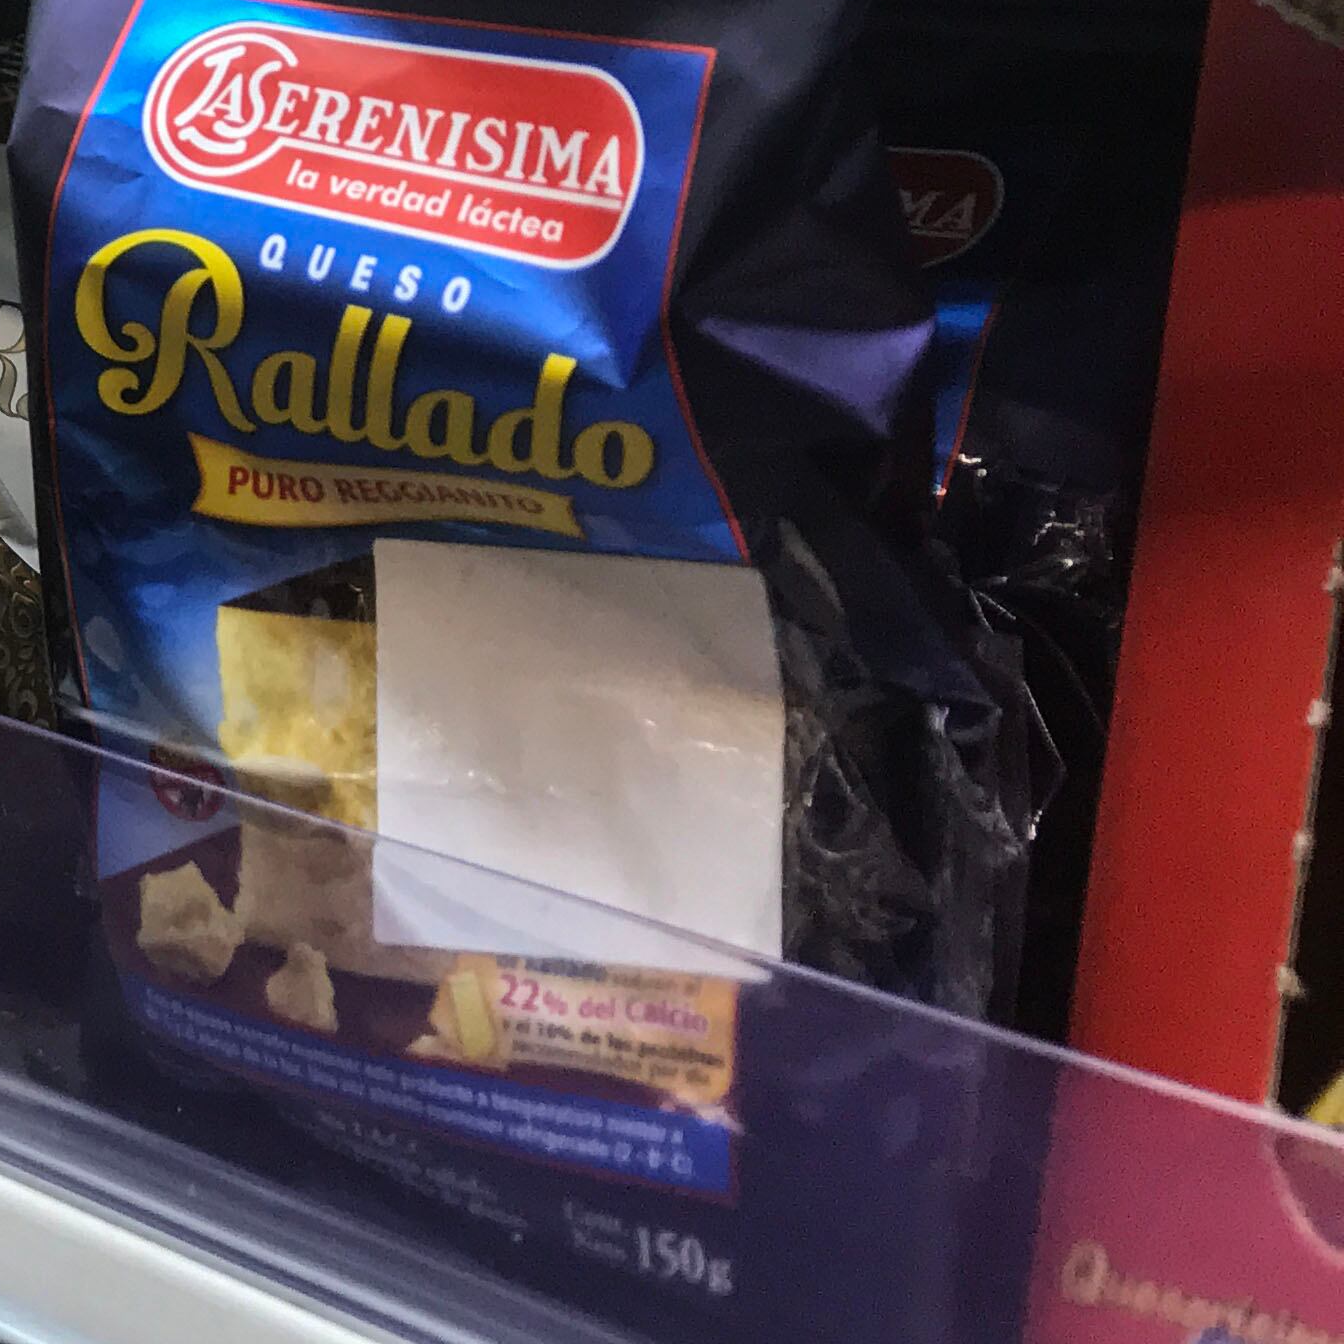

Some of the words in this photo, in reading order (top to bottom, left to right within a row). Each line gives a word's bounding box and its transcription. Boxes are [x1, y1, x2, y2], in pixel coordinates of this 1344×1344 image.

[285, 159, 318, 189] la
[329, 175, 448, 218] verdad
[457, 190, 565, 244] láctea
[260, 232, 473, 314] QUESO
[75, 227, 656, 490] Rallado
[226, 464, 325, 505] PURO
[335, 476, 545, 517] REGGIANITO
[578, 996, 616, 1020] del
